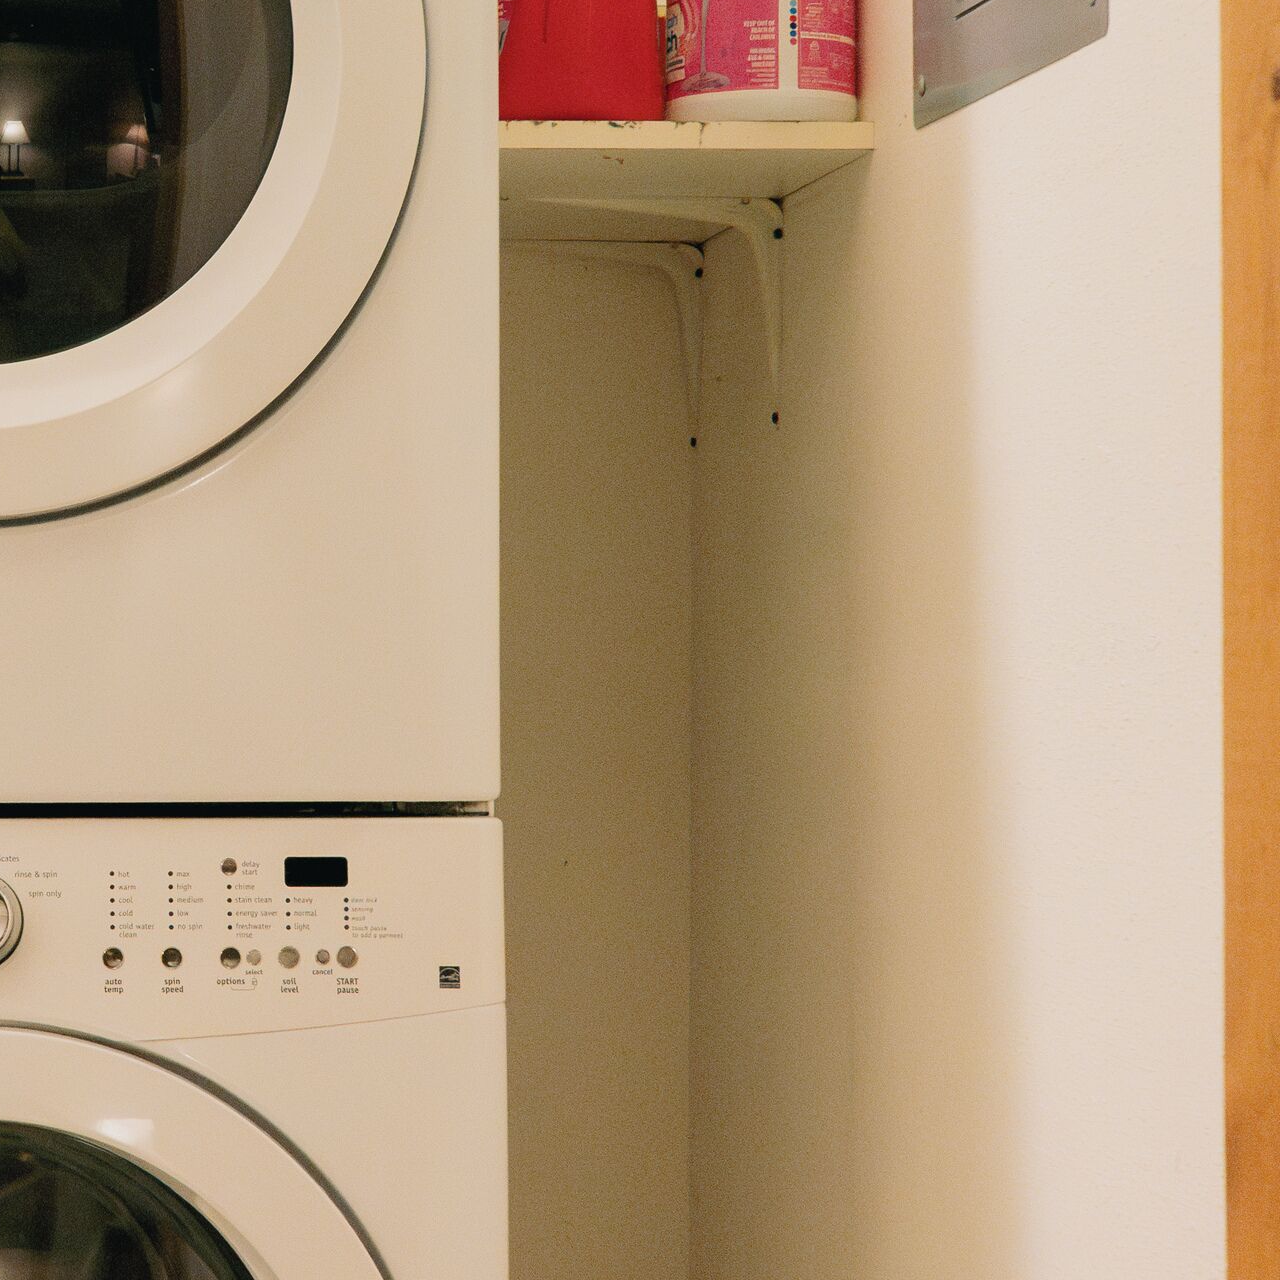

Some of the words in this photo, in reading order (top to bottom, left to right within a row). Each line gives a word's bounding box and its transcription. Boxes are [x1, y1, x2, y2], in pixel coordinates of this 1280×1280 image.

[241, 860, 260, 869] delay
[14, 871, 32, 879] rinse
[42, 871, 58, 879] spin
[176, 883, 192, 892] high
[28, 890, 44, 899] spin
[46, 890, 62, 899] only
[293, 897, 313, 905] heavy
[188, 923, 203, 931] spin
[294, 923, 310, 931] light
[164, 977, 181, 986] spin
[216, 977, 246, 986] options
[282, 977, 297, 985] soil
[336, 977, 359, 986] START
[104, 986, 124, 994] temp
[161, 985, 184, 994] speed
[336, 986, 359, 995] pause
